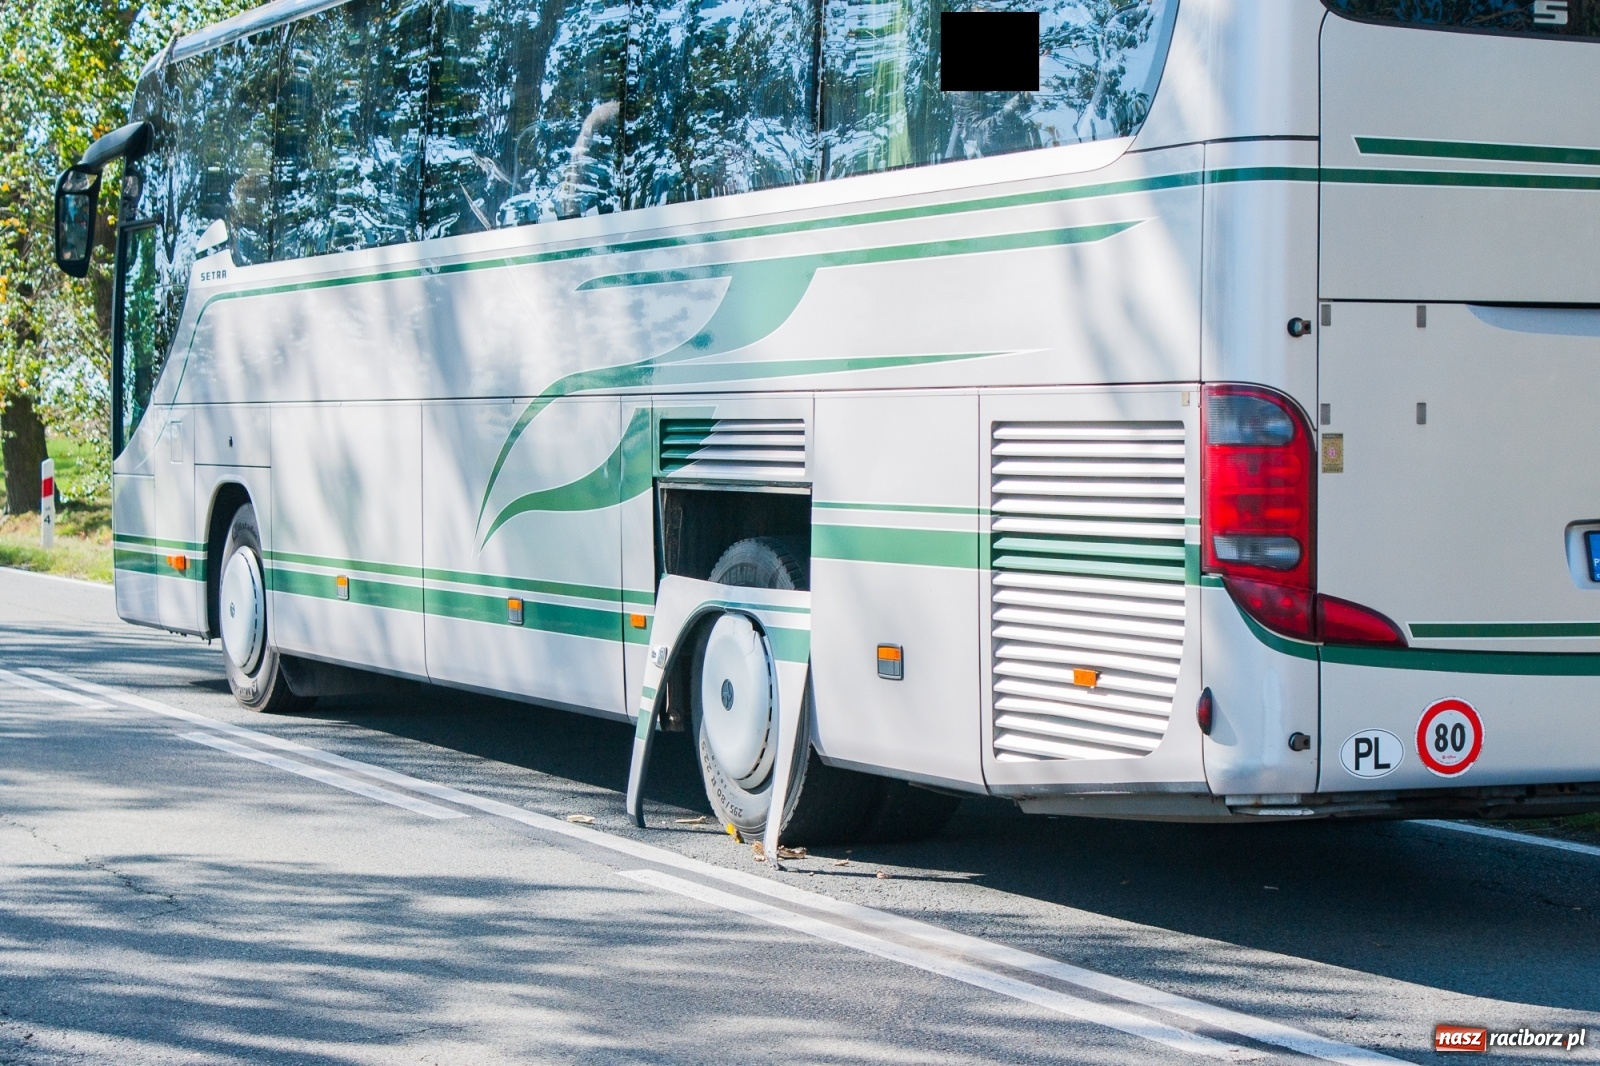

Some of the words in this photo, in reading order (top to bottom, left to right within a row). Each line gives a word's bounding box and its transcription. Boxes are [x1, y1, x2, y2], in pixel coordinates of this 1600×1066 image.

[1534, 0, 1568, 25] S
[200, 269, 227, 281] SETRA
[44, 514, 51, 525] 4
[1434, 722, 1466, 753] 80
[1354, 736, 1391, 771] PL
